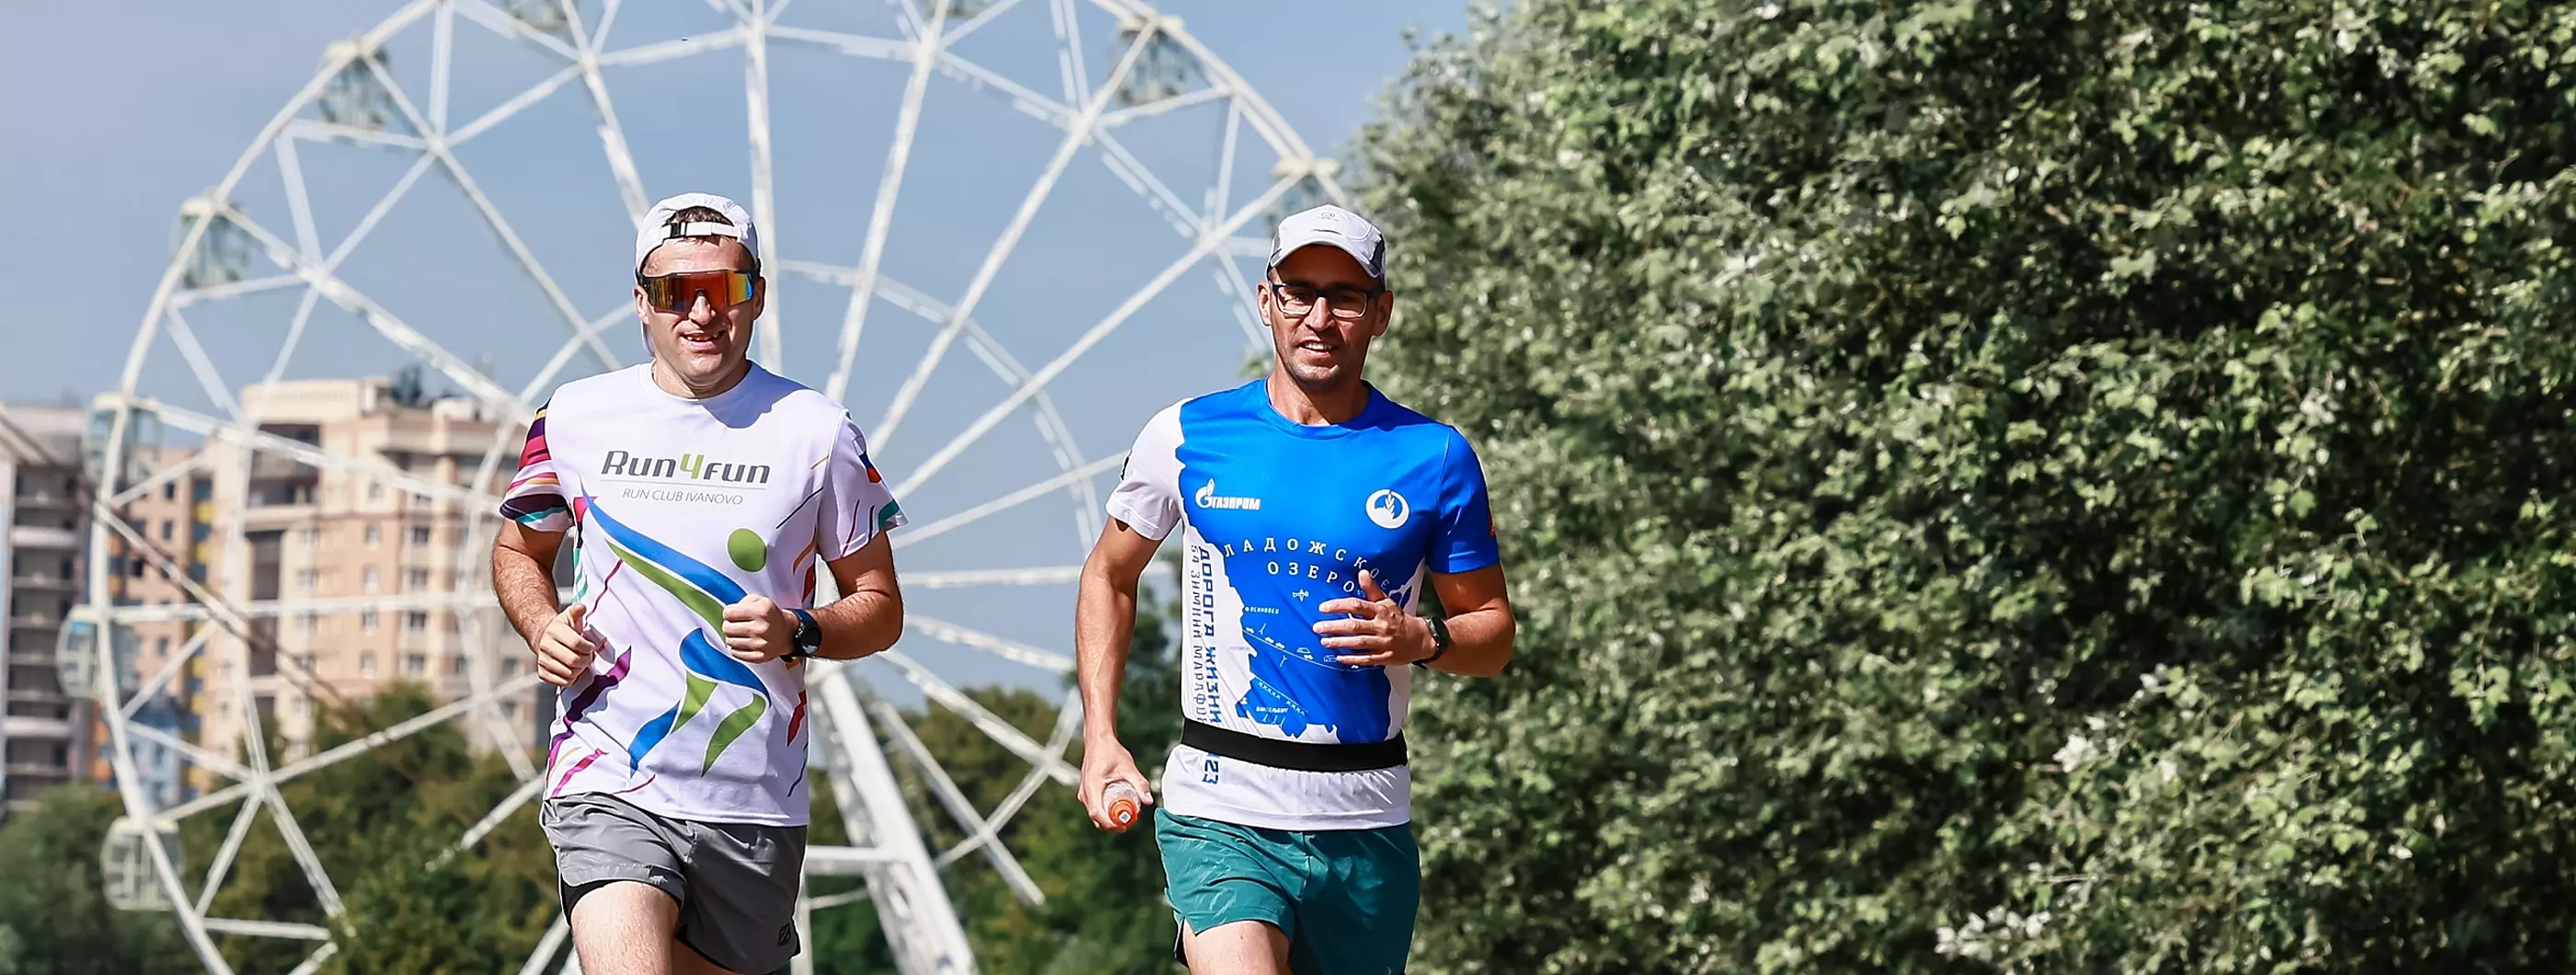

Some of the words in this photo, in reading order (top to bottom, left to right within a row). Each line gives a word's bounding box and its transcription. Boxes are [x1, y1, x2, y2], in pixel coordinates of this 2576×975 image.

[623, 488, 650, 499] RUN
[651, 489, 683, 502] CLUB
[685, 492, 743, 505] IVANOVO
[1212, 496, 1260, 510] ГАЗПРОМ
[1198, 545, 1214, 637] ДОРОГА
[1267, 561, 1355, 593] ОЗЕРО
[1193, 646, 1207, 721] МАРАФО
[1206, 647, 1222, 723] ЖИЗНИ
[1202, 752, 1219, 785] 23
